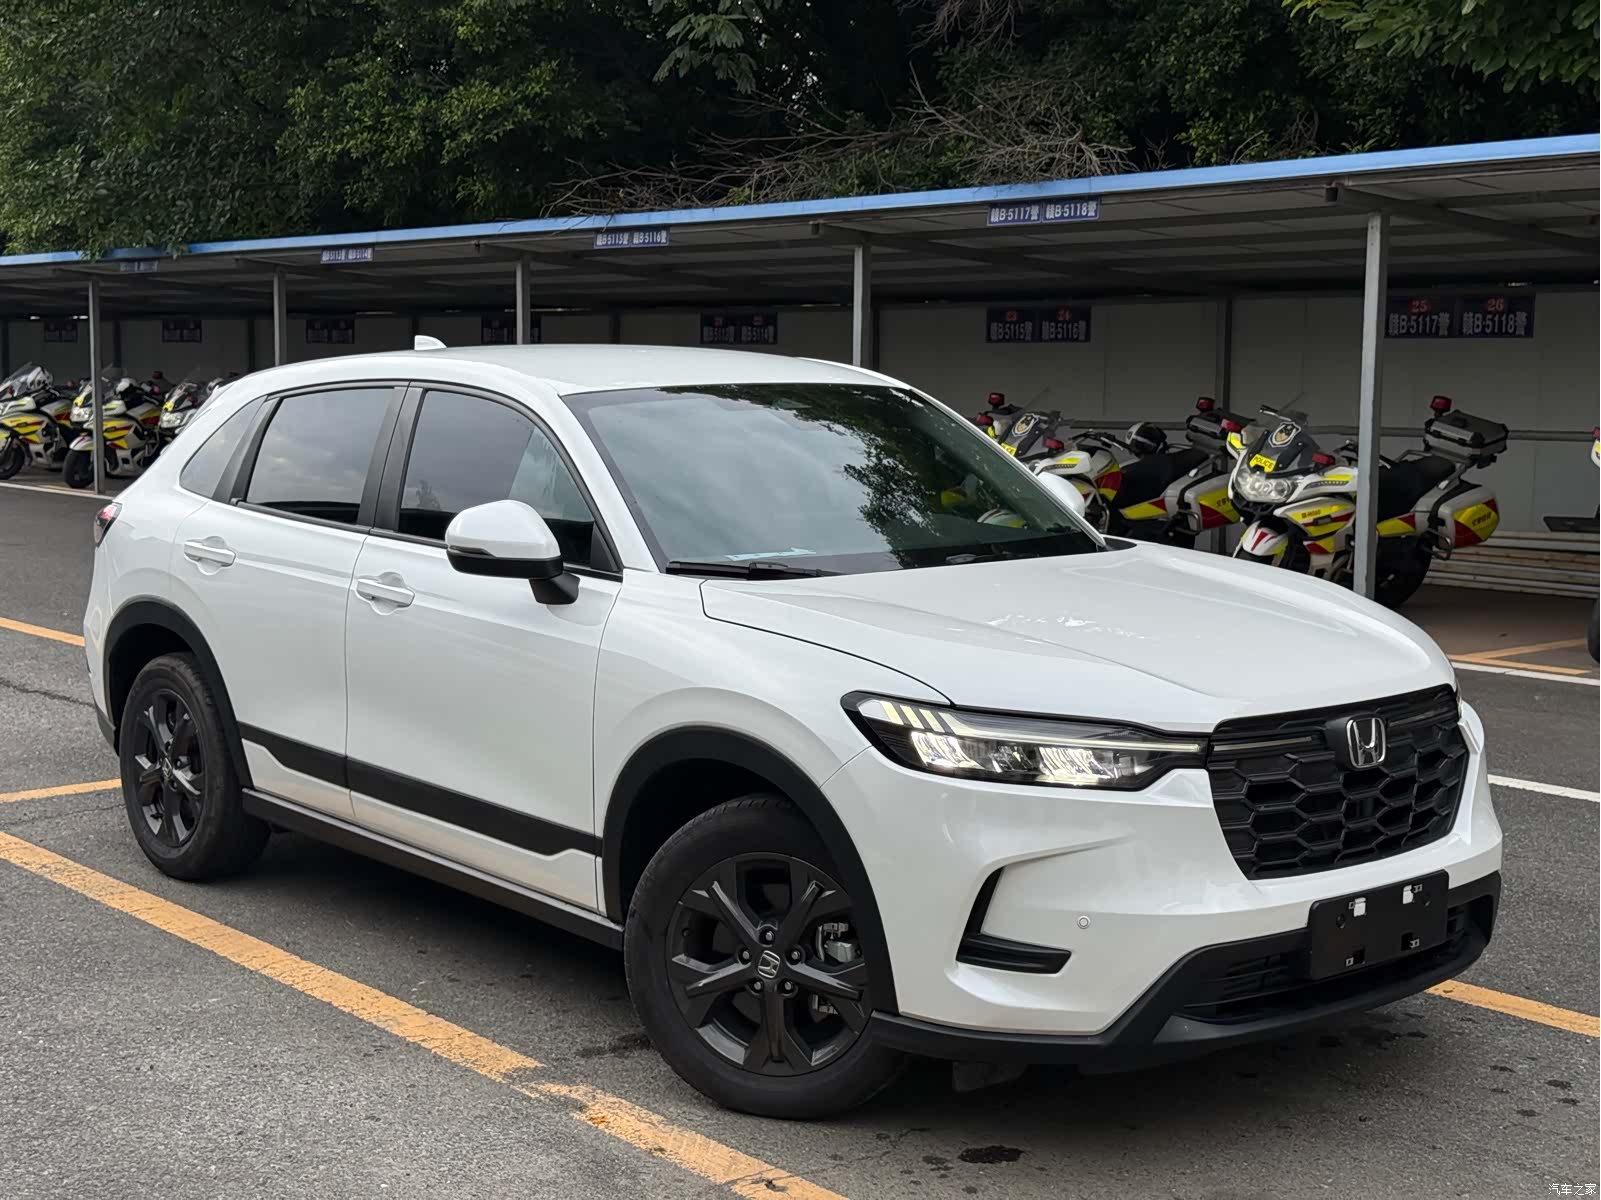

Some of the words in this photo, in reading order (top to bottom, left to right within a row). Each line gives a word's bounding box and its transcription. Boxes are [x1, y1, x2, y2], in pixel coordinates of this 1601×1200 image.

[1410, 300, 1429, 313] 25
[1486, 298, 1505, 311] 26
[1252, 455, 1274, 470] POLICE
